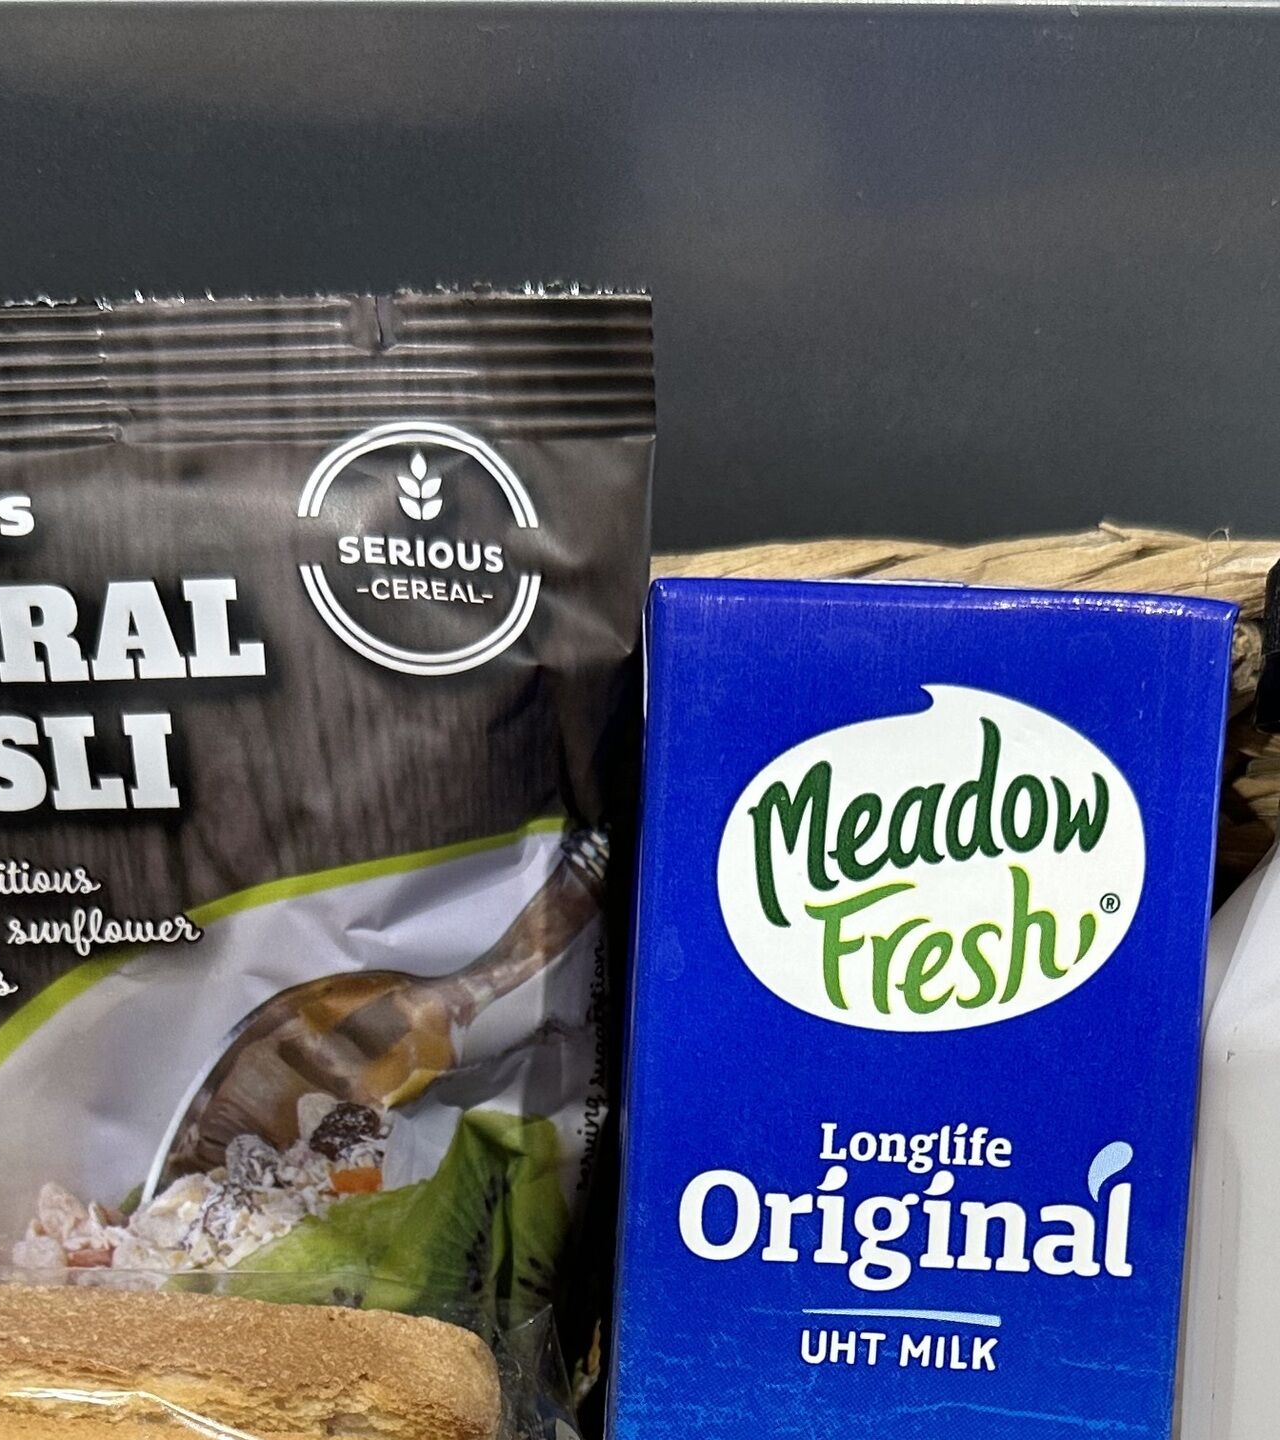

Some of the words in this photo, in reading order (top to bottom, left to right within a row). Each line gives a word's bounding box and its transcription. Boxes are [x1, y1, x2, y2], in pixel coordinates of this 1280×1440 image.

[338, 536, 504, 573] SERIOUS
[747, 716, 1110, 928] Meadow
[7, 907, 202, 957] sunflower
[804, 865, 1096, 1014] Fresh
[820, 1121, 1012, 1174] Longlife
[678, 1141, 1133, 1291] Original
[801, 1330, 887, 1365] UHT
[899, 1334, 998, 1372] MILK
